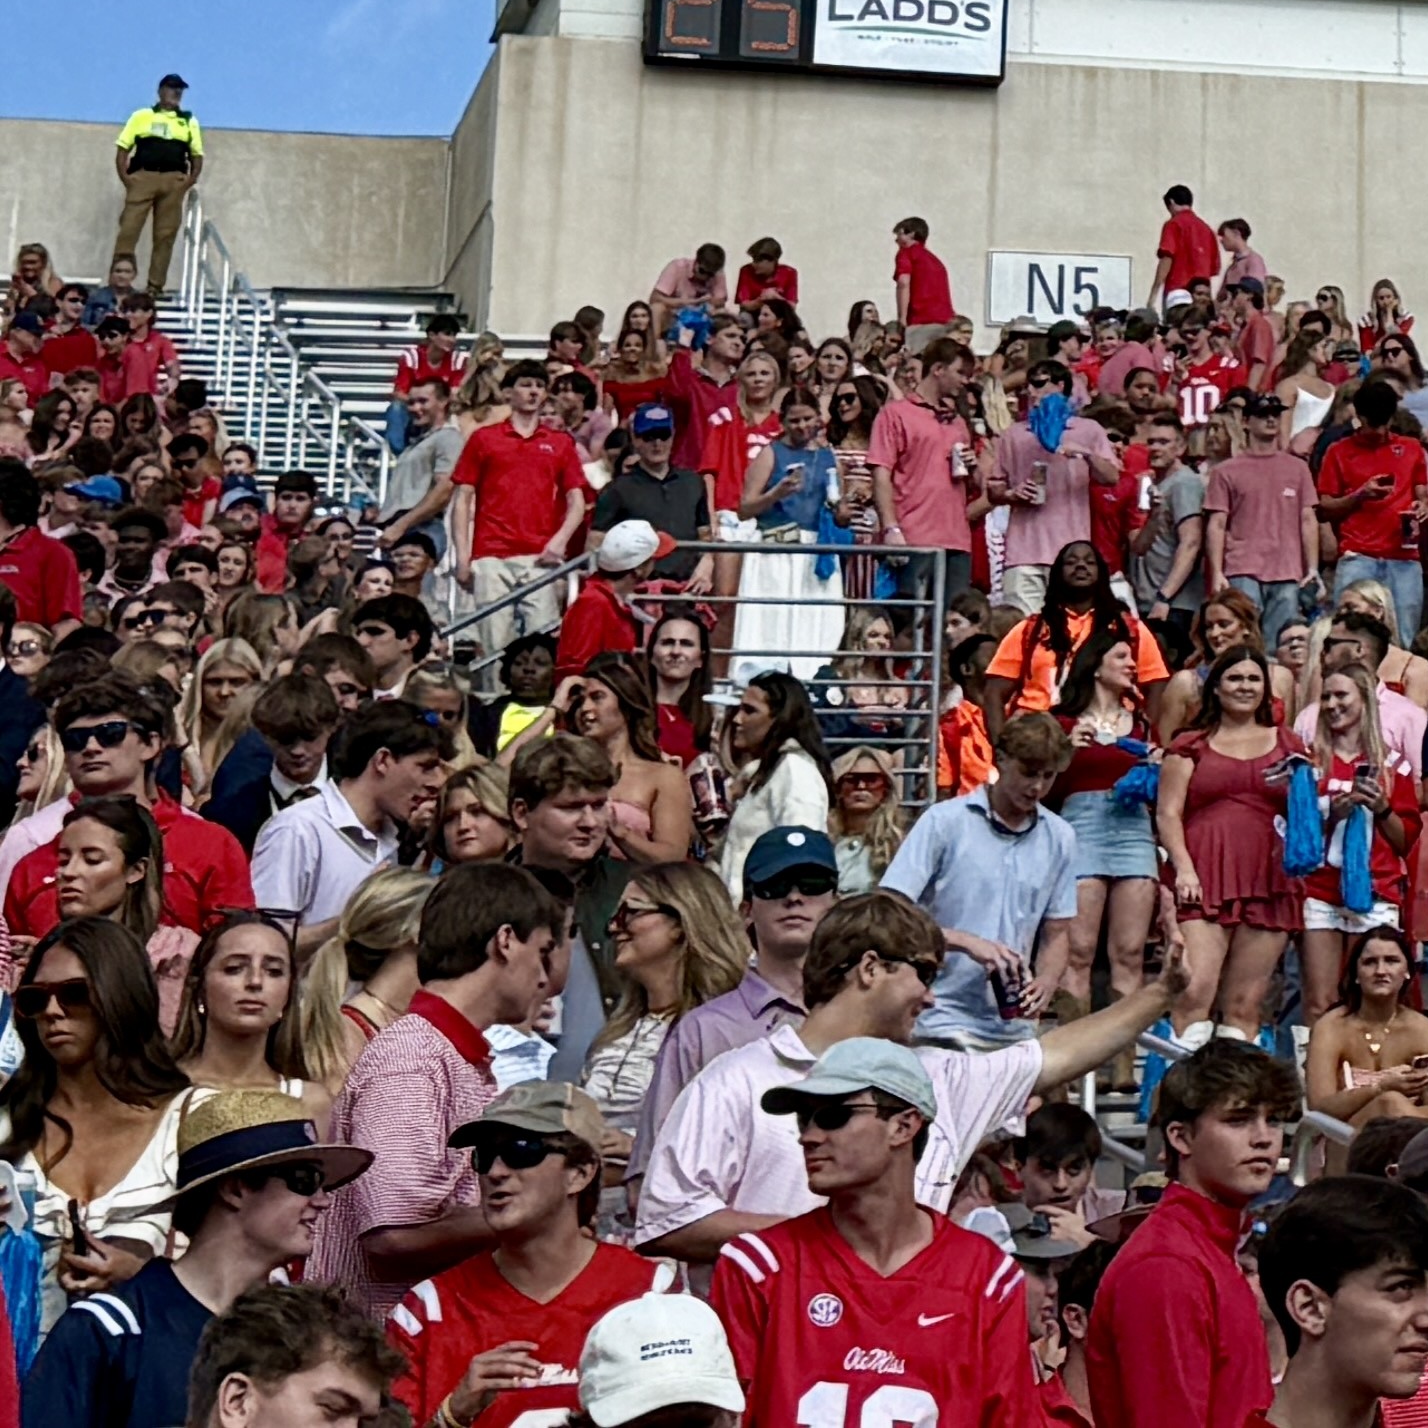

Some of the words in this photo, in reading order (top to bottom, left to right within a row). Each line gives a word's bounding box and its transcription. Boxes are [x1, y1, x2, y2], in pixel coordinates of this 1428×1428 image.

[1027, 262, 1100, 317] N5
[1180, 385, 1220, 425] 10
[843, 1346, 871, 1371] Ole
[866, 1347, 906, 1375] Miss
